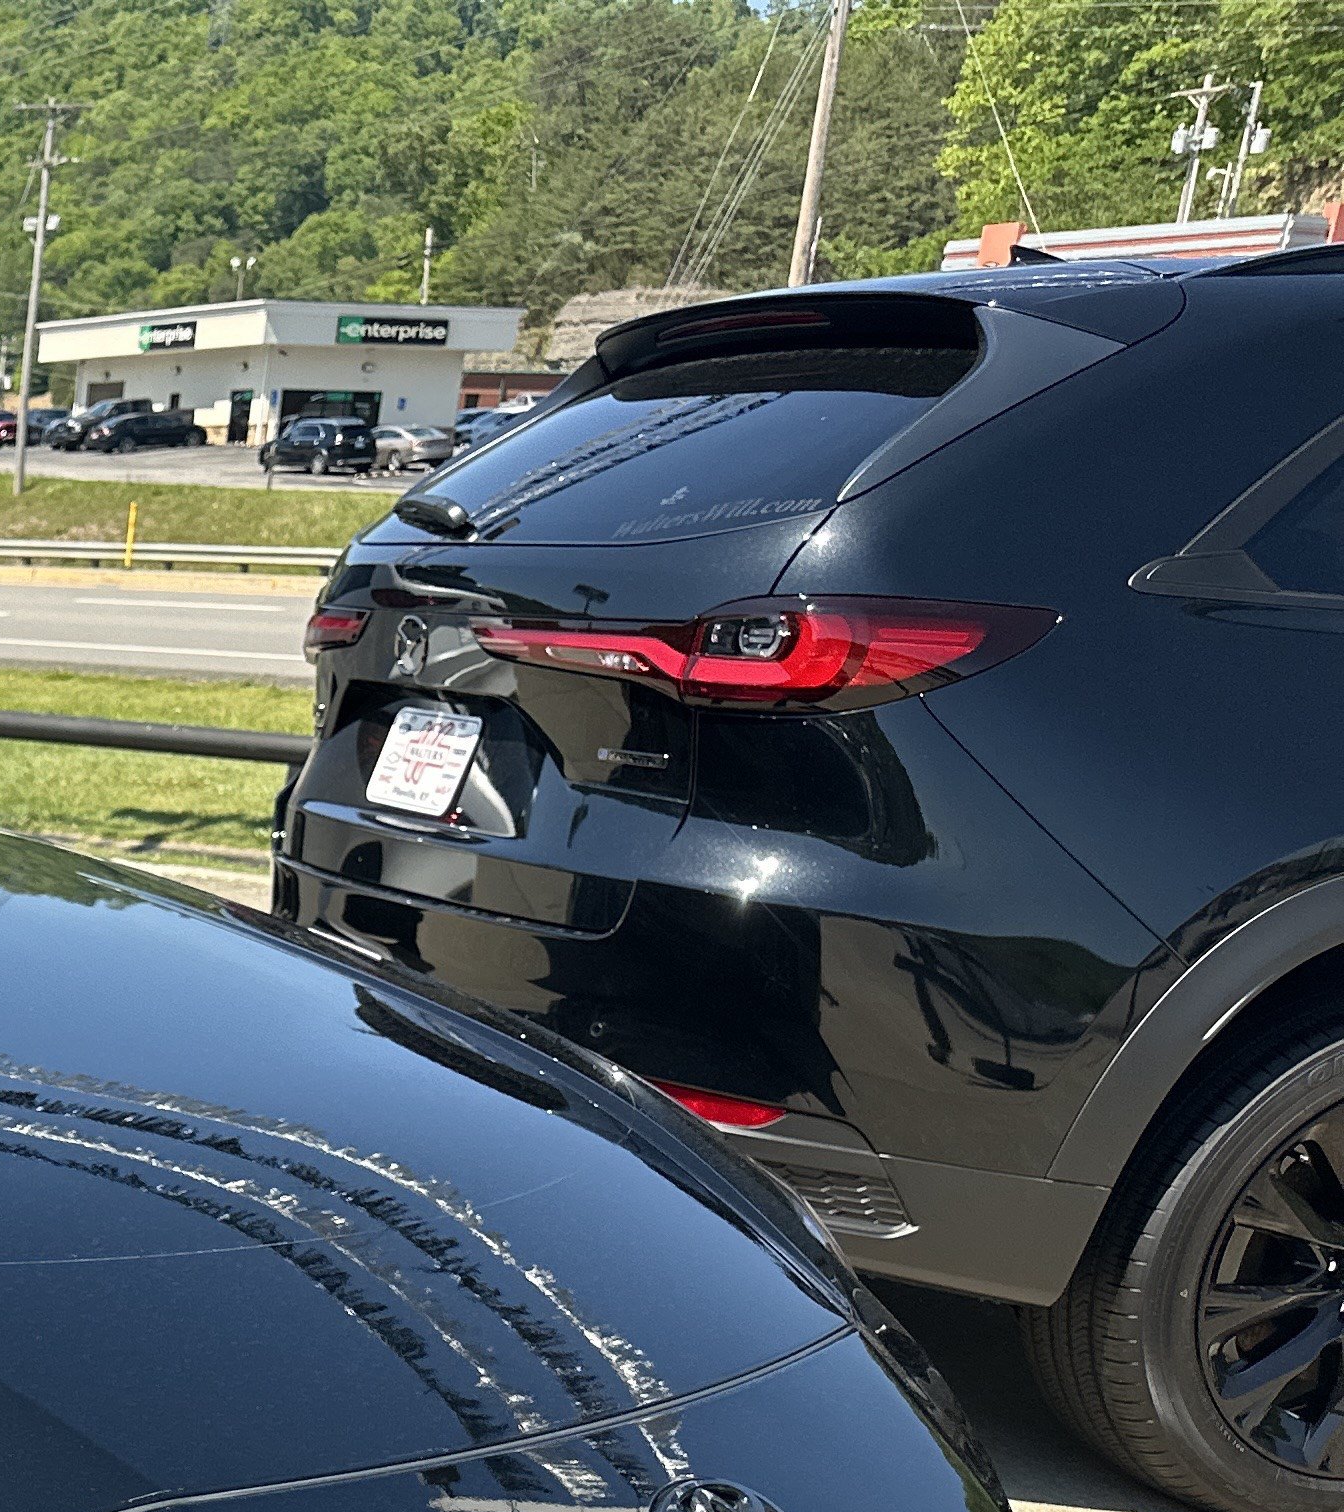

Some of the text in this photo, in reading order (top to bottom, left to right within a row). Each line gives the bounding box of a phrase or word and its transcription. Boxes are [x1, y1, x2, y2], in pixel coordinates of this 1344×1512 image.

[141, 324, 193, 346] enterprise
[340, 322, 447, 342] enterprise
[612, 498, 822, 538] WaltersWill.com
